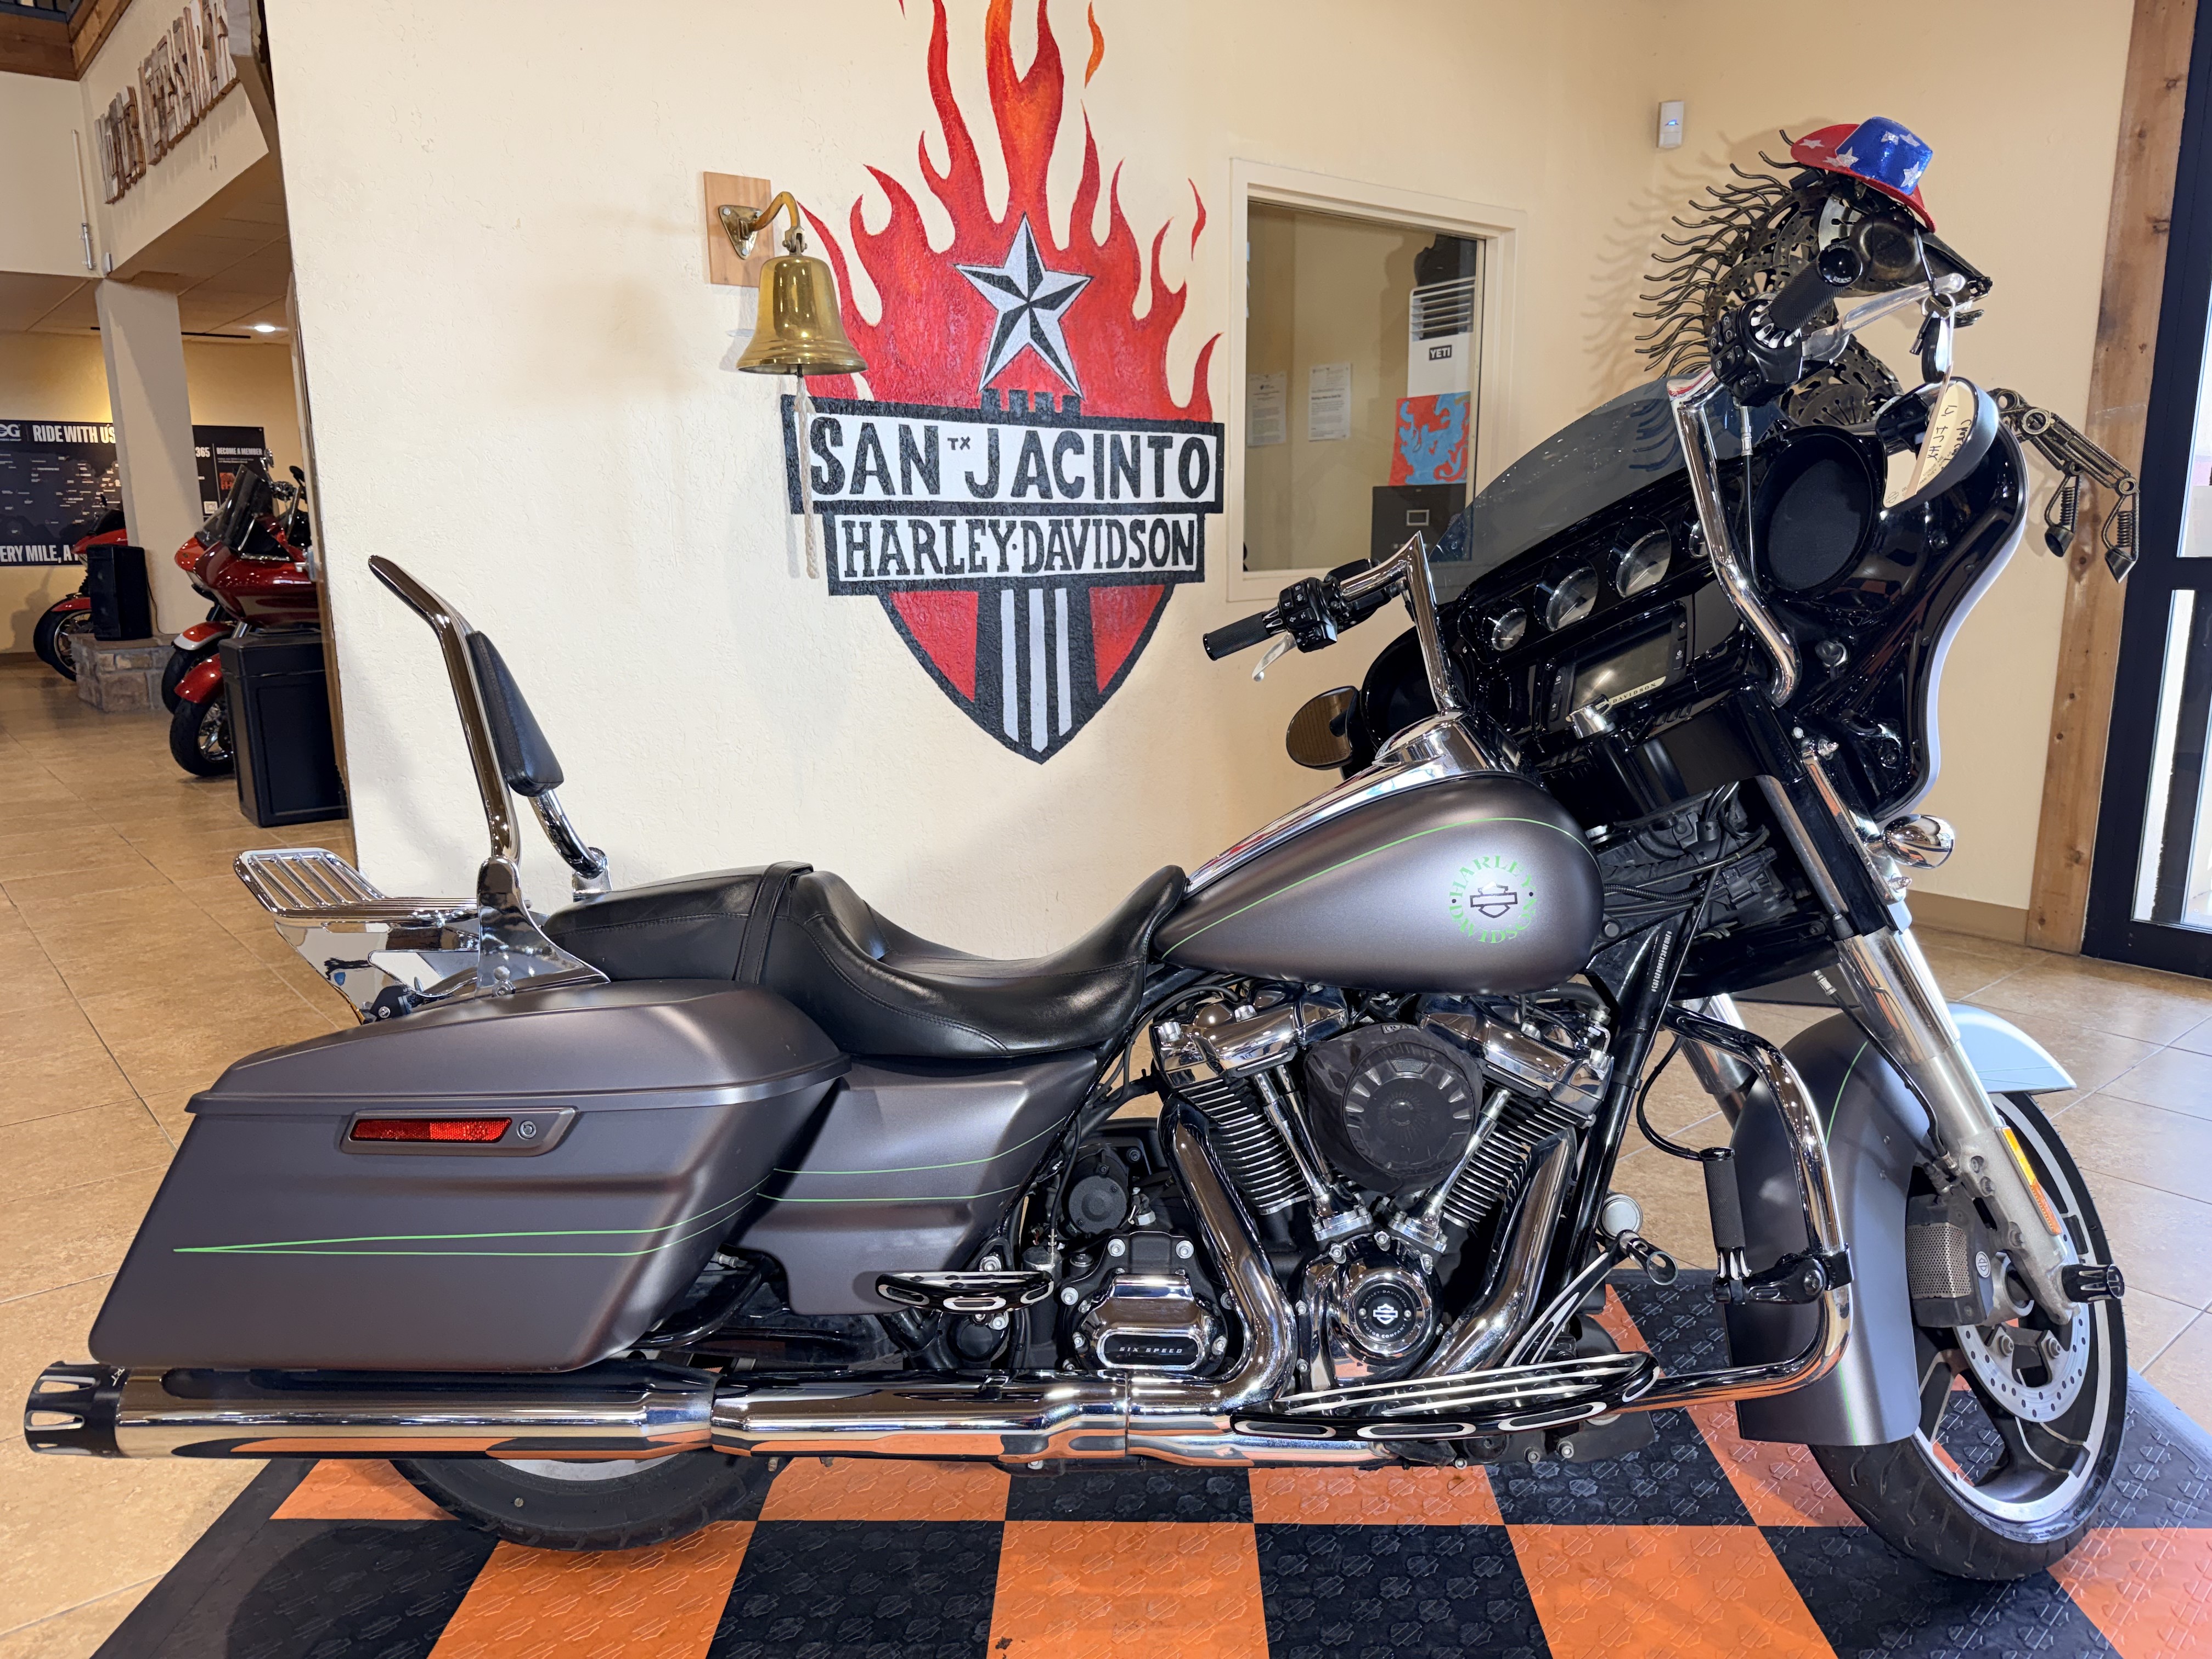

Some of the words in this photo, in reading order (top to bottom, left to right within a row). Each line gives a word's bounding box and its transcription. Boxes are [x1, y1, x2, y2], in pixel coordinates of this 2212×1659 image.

[1430, 347, 1451, 358] YETI
[32, 425, 63, 442] RIDE
[64, 426, 98, 443] WITH
[99, 426, 116, 444] US
[195, 447, 211, 458] 365
[810, 416, 941, 496] SAN
[947, 436, 971, 452] TX
[964, 426, 1209, 500] JACINTO
[0, 545, 22, 562] ERY
[25, 545, 61, 563] MILE,
[63, 545, 72, 561] A
[1613, 683, 1656, 703] DAVIDSON
[1449, 855, 1536, 898] HARLEY
[1448, 898, 1537, 944] DAVIDSON
[1363, 1322, 1380, 1337] MOTOR
[1381, 1323, 1406, 1339] COMPANY
